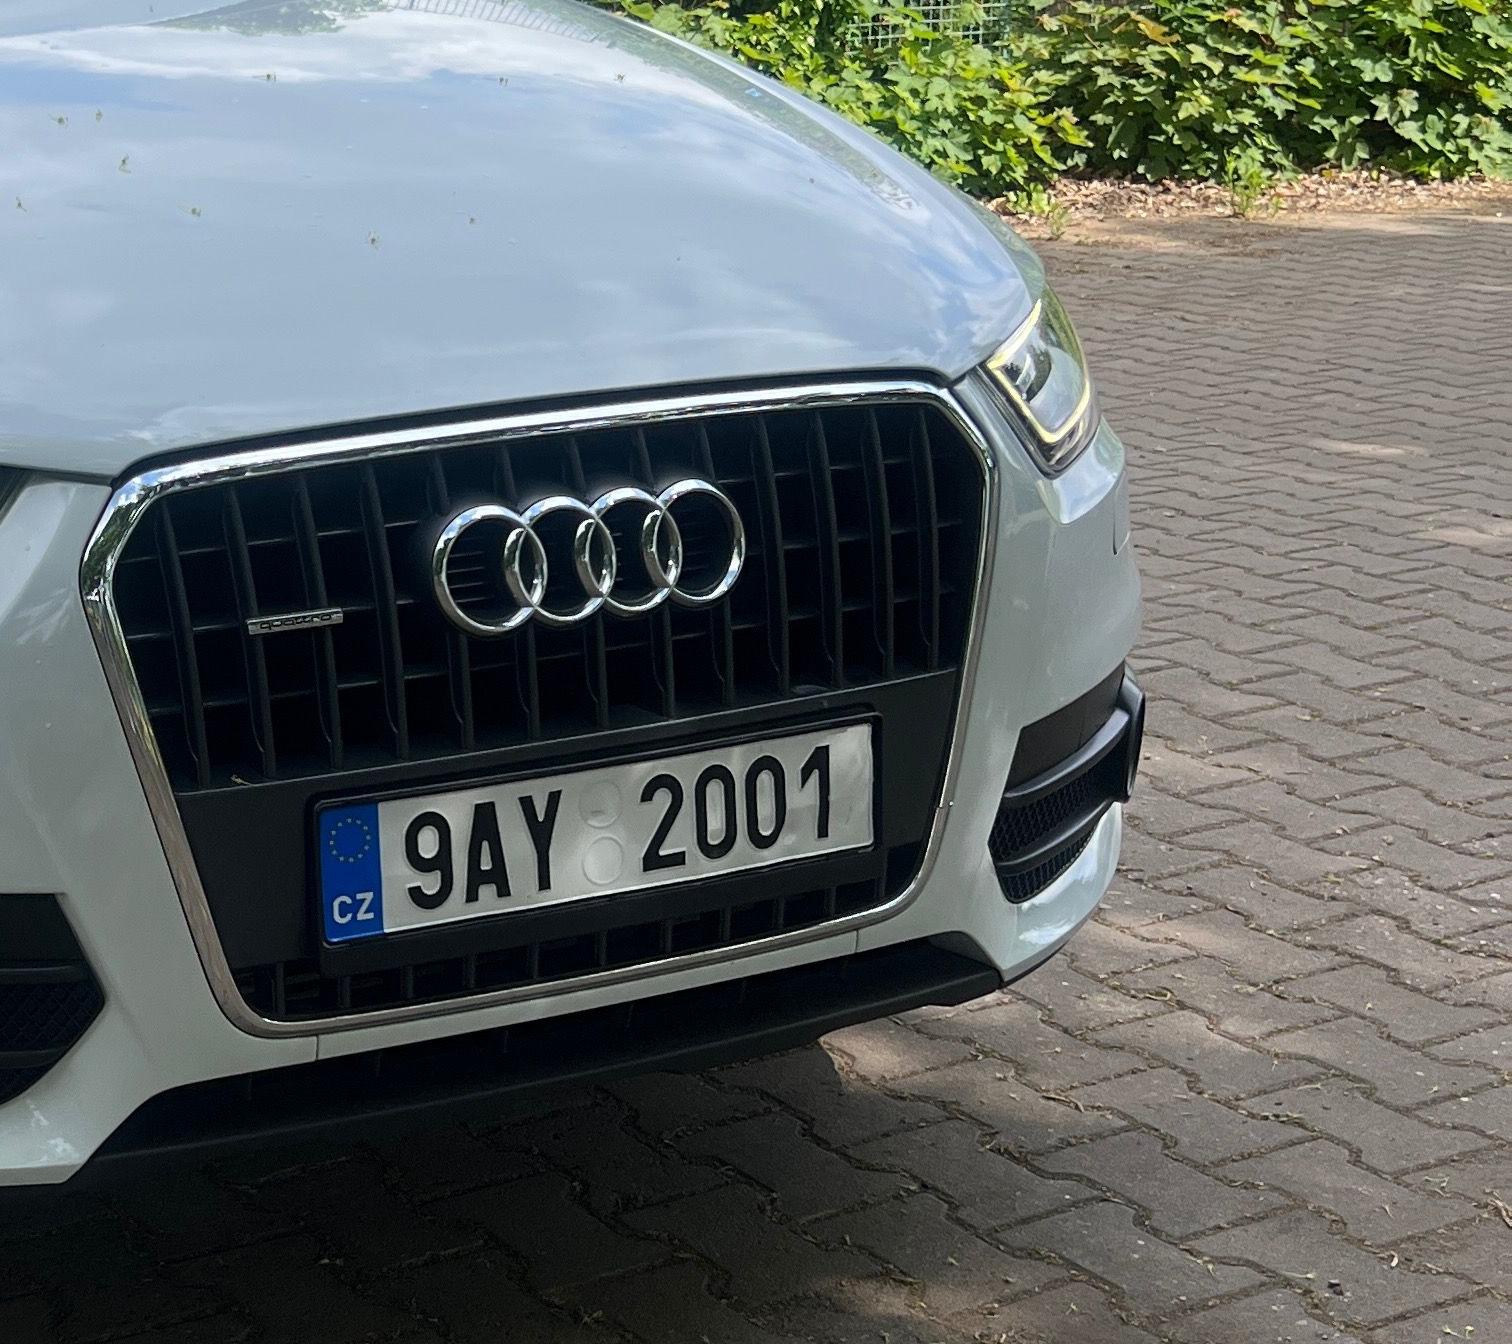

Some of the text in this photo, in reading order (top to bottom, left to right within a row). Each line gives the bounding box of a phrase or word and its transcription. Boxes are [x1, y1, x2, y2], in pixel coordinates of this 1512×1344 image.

[260, 613, 331, 631] quattro
[404, 743, 832, 910] 9AY 2001
[332, 890, 375, 925] CZ
